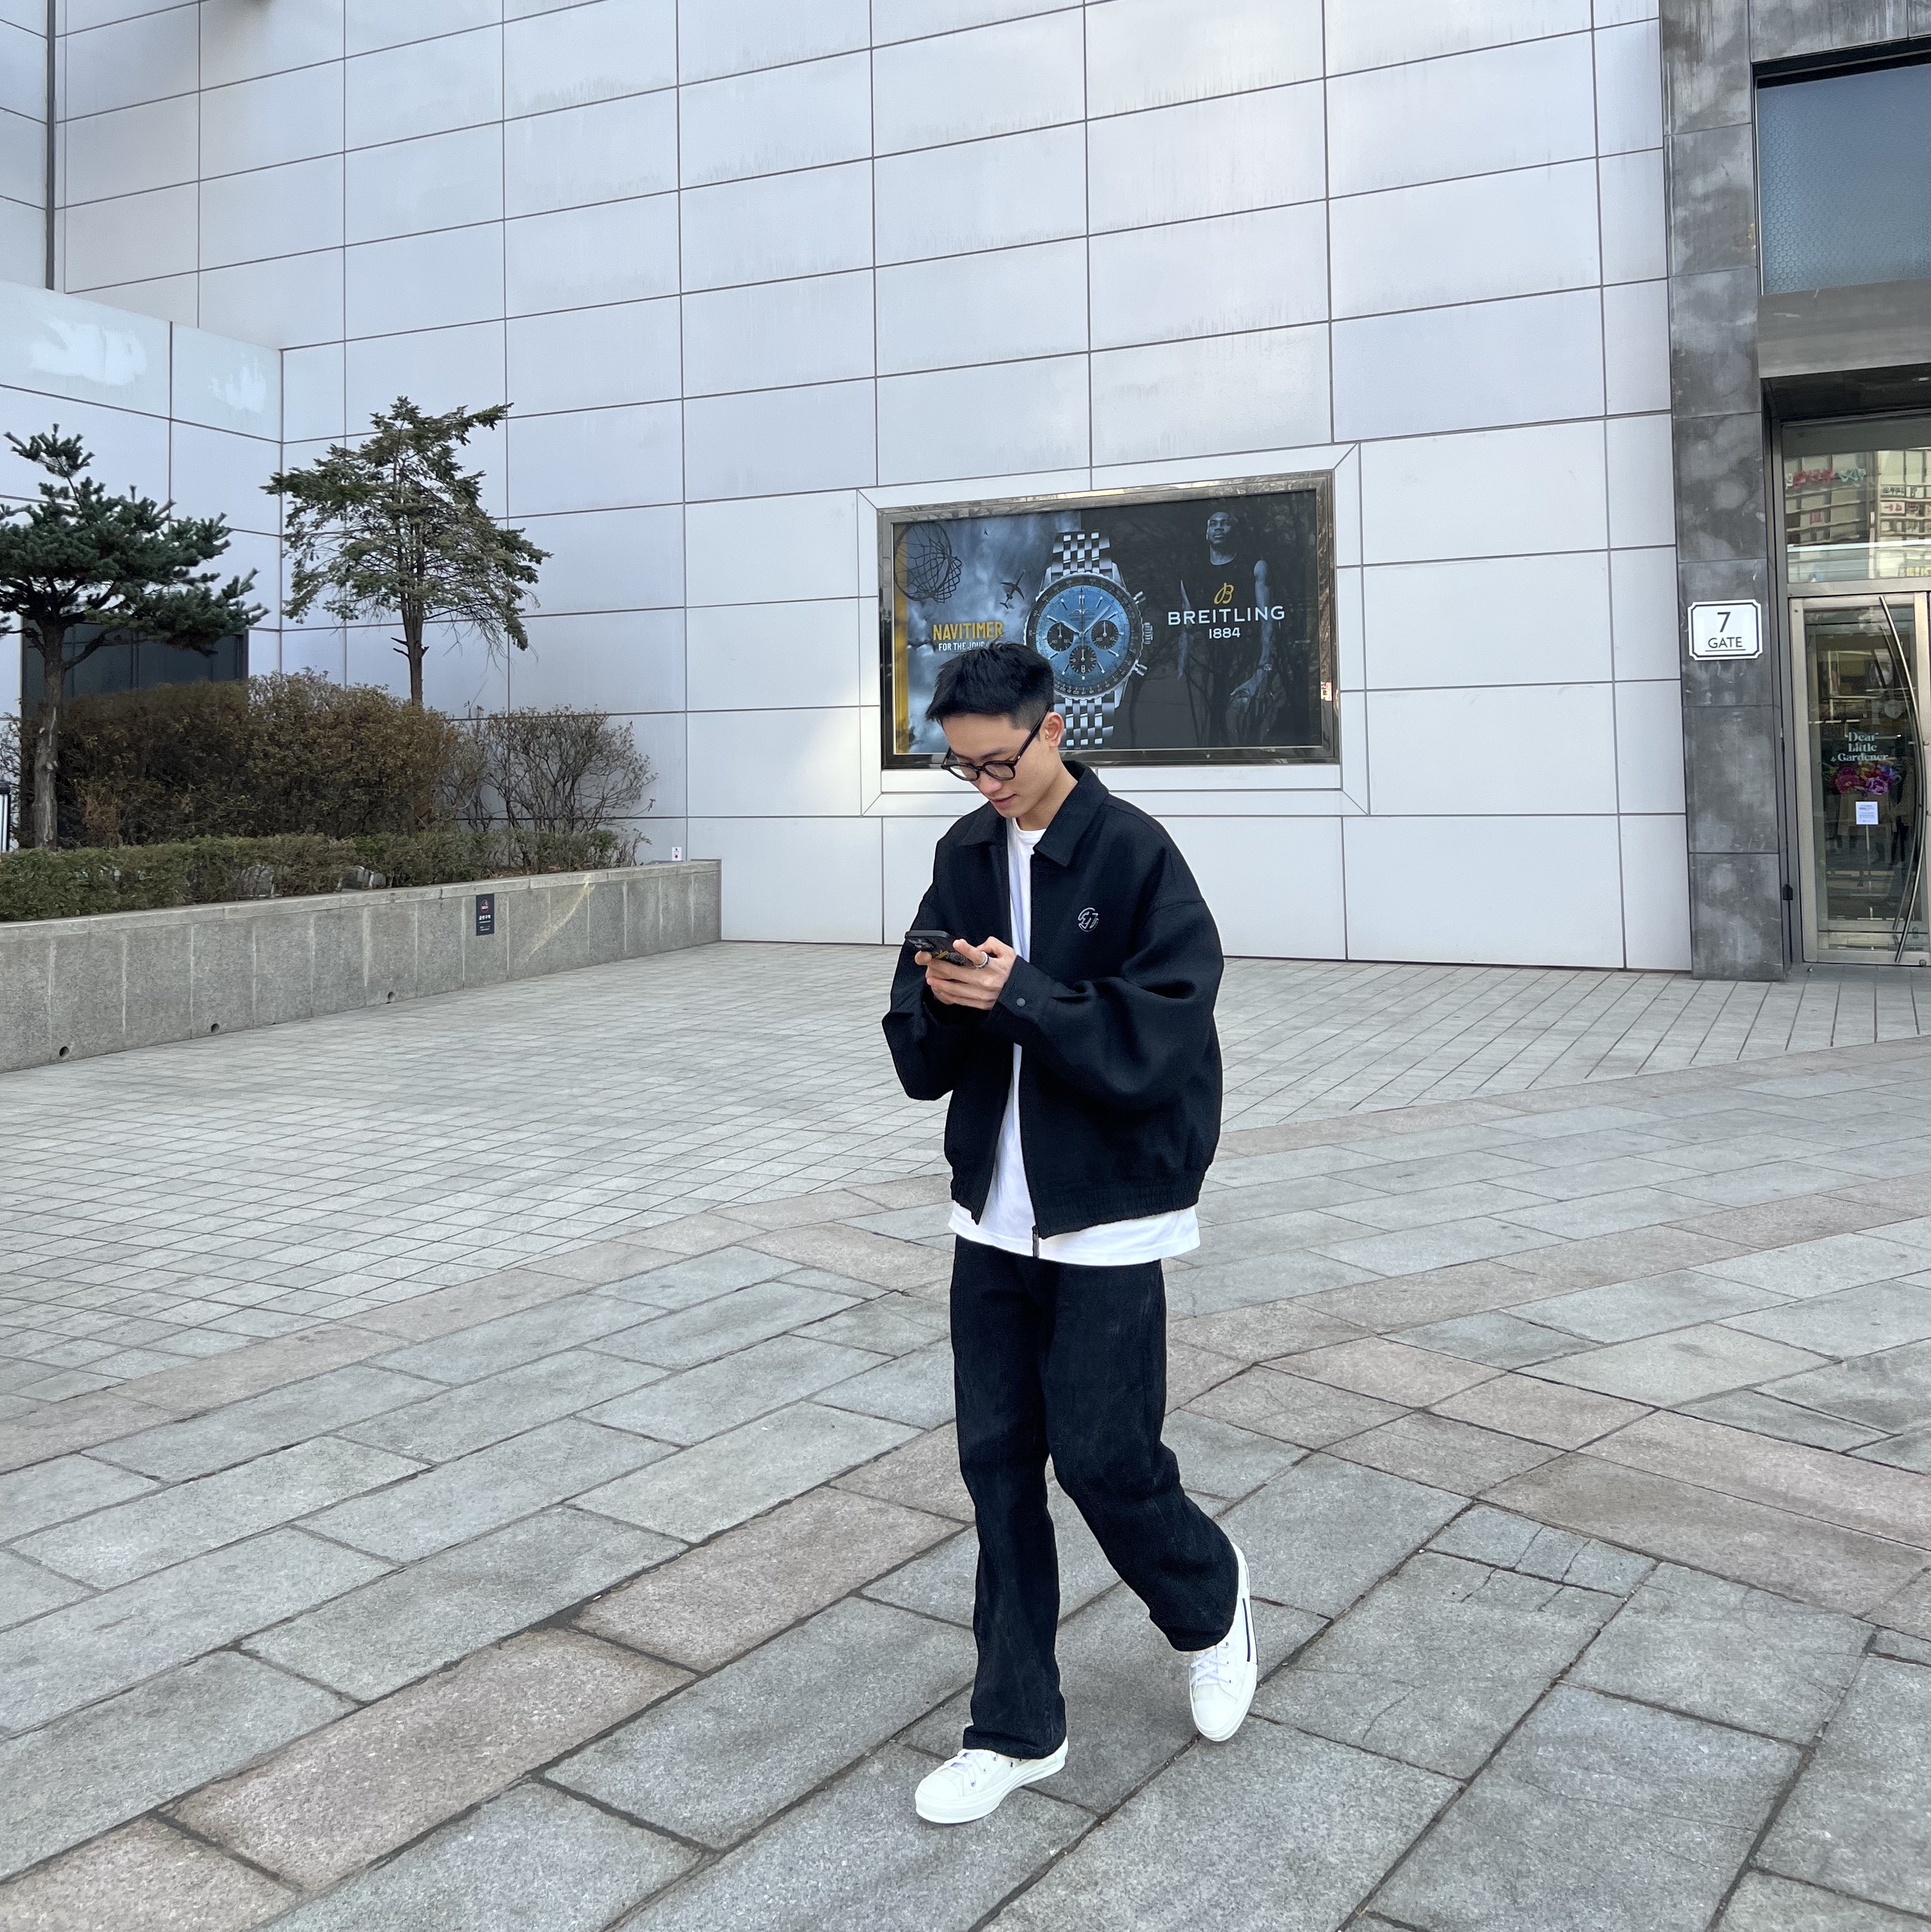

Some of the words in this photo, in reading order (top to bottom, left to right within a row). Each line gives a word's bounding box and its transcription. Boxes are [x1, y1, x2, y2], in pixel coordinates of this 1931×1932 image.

[1168, 606, 1285, 625] BREITLING
[1717, 611, 1731, 632] 7
[933, 621, 1004, 641] NAVITIMER
[1209, 627, 1241, 639] 1884
[938, 643, 952, 652] FOR
[953, 642, 966, 651] THE
[1707, 636, 1743, 648] GATE
[1848, 732, 1879, 742] Dear
[1848, 742, 1877, 752] Little
[1837, 753, 1889, 762] Gardener
